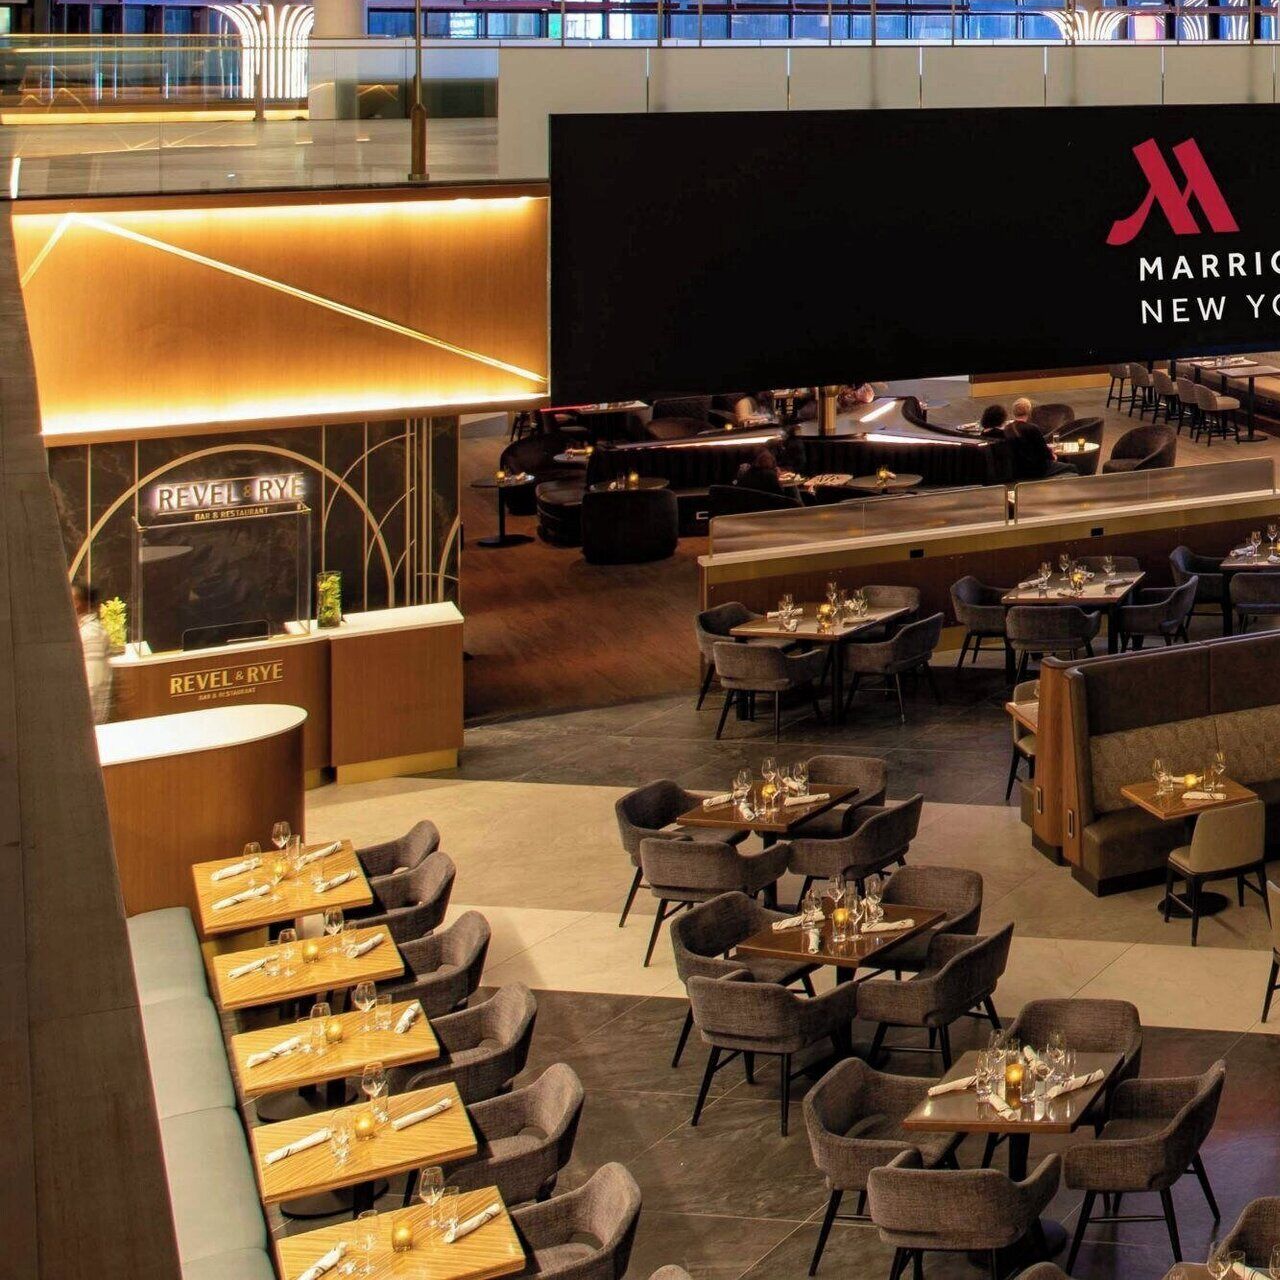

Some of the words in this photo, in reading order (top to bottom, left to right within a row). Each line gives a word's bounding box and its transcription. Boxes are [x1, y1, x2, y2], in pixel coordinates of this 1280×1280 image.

[1140, 295, 1227, 324] NEW
[158, 481, 238, 511] REVEL
[258, 475, 305, 502] RYE
[194, 513, 210, 521] BAR
[220, 507, 269, 518] RESTAURANT
[170, 670, 233, 695] REVEL
[235, 670, 245, 681] &
[247, 663, 284, 683] RYE
